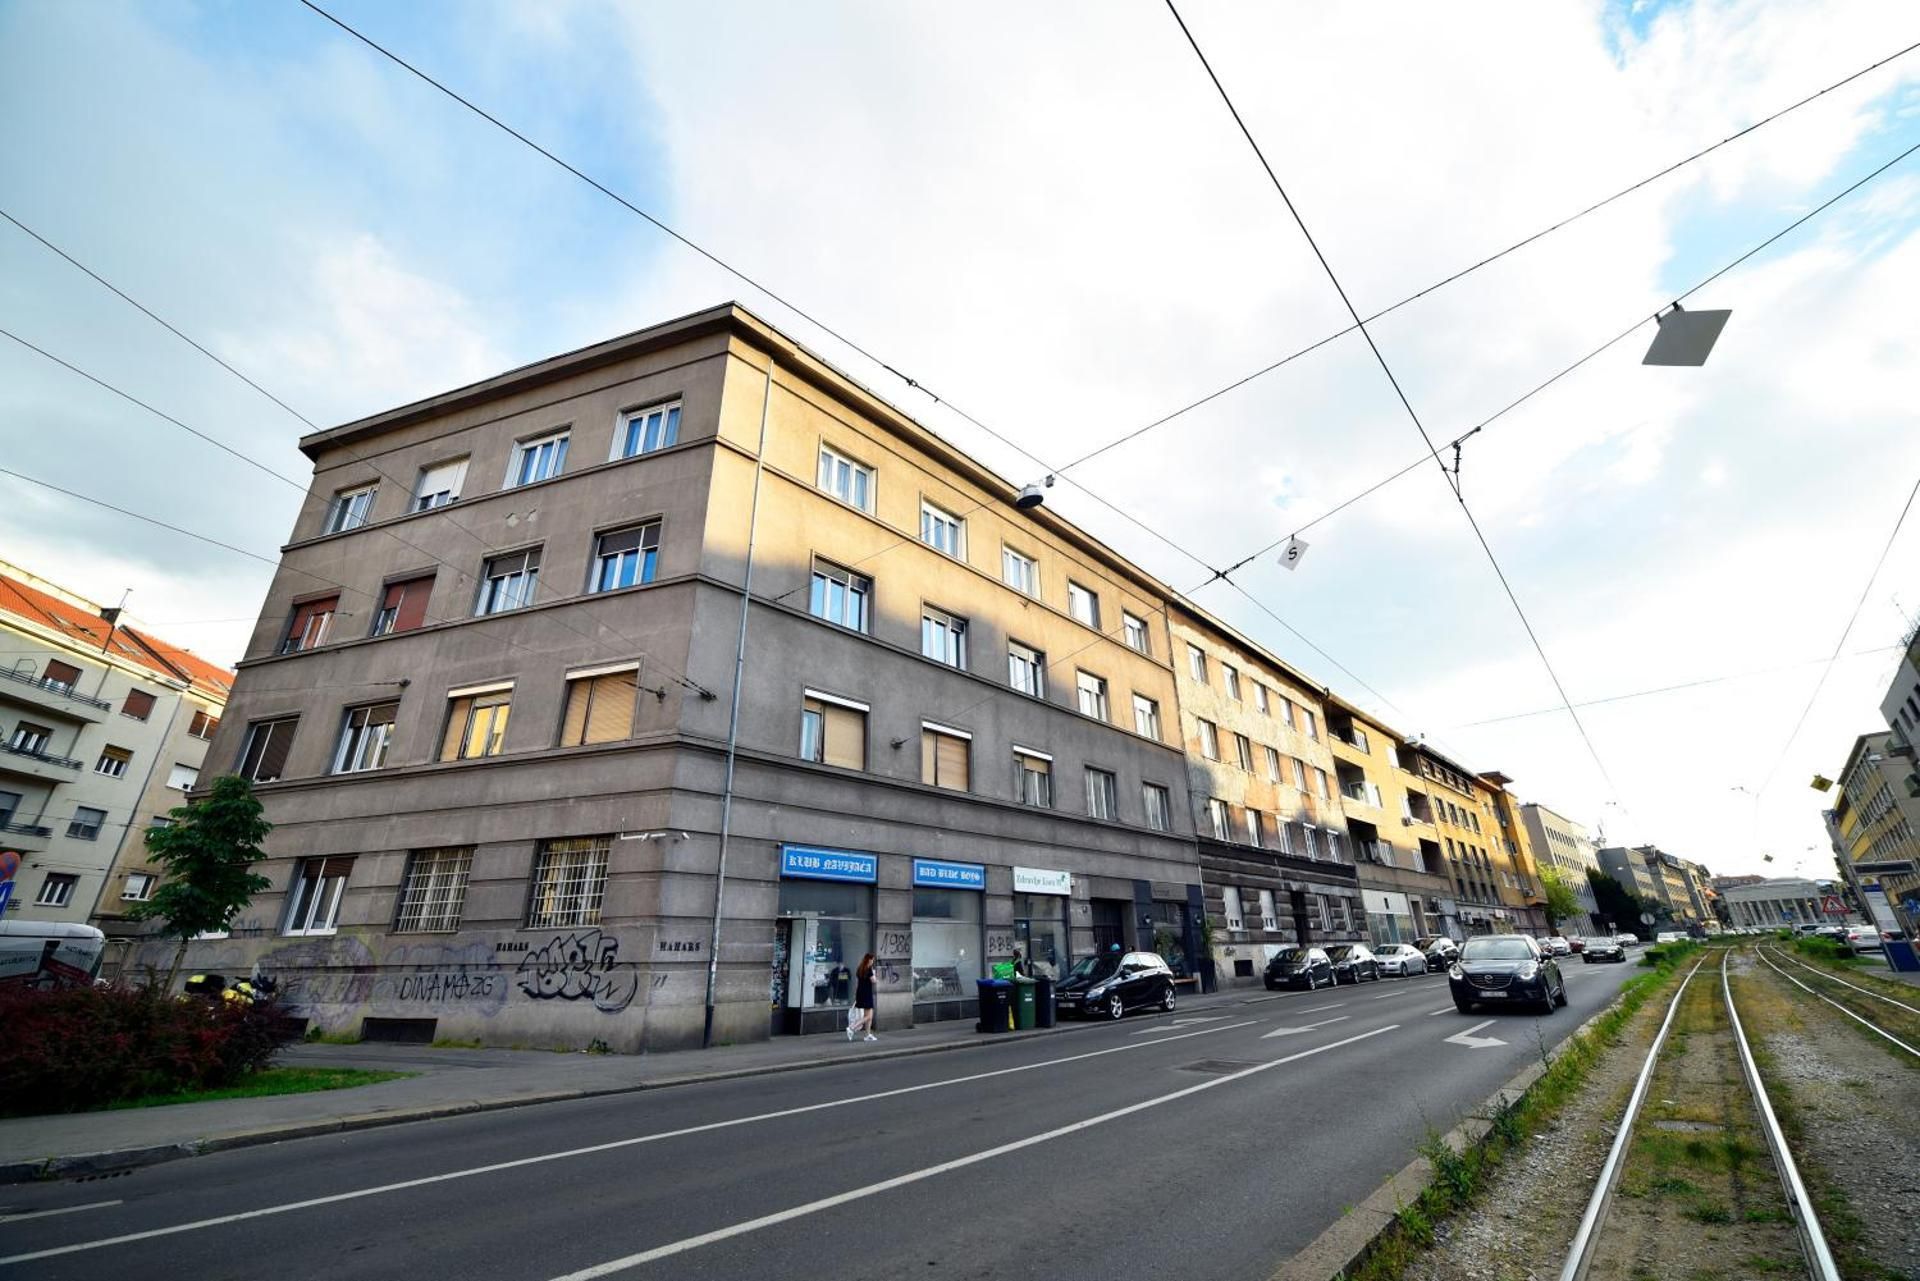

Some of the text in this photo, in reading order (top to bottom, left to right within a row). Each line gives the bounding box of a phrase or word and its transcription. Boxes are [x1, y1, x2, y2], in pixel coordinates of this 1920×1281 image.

[1288, 547, 1298, 560] S
[789, 855, 820, 869] KLUB
[919, 866, 937, 878] BAD
[938, 868, 959, 879] BLUE
[988, 936, 1014, 953] BBB
